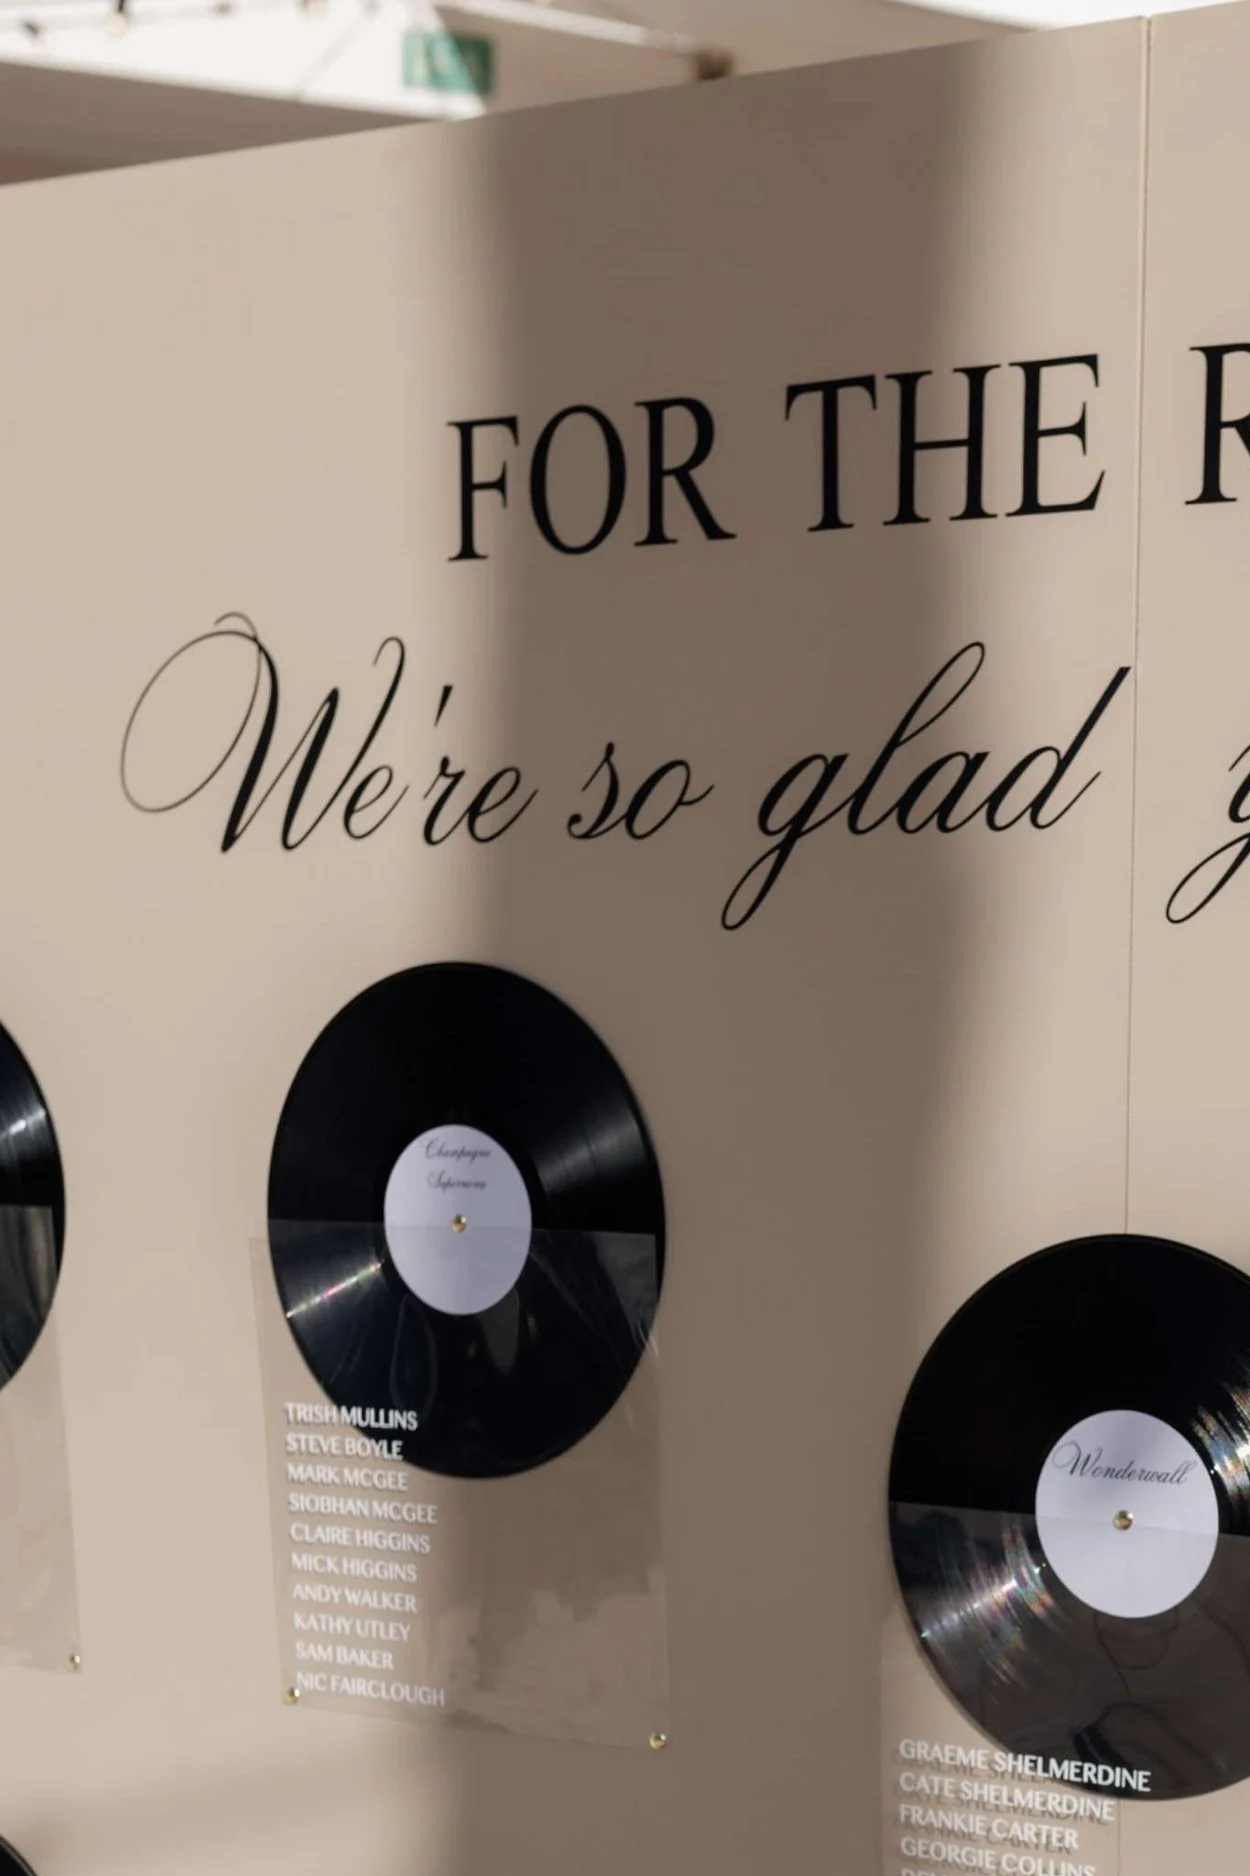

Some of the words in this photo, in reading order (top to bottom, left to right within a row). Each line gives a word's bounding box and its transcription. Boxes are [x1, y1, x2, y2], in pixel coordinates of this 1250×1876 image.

[447, 396, 737, 562] FOR
[784, 353, 1105, 532] THE
[121, 612, 539, 853] We're
[568, 742, 714, 840] so
[720, 641, 1132, 930] glad
[421, 1137, 492, 1165] Champagne
[427, 1170, 487, 1193] Supernova
[284, 1403, 337, 1426] TRISH
[341, 1407, 417, 1431] MULLINS
[286, 1433, 340, 1455] STEVE
[346, 1437, 403, 1460] BOYLE
[287, 1464, 340, 1485] MARK
[344, 1468, 408, 1491] MCGEE
[1052, 1440, 1197, 1485] Wonderwall
[289, 1493, 370, 1517] SIOBHAN
[373, 1500, 438, 1523] MCGEE
[291, 1523, 352, 1546] CLAIRE
[356, 1529, 431, 1554] HIGGINS
[291, 1554, 338, 1575] MICK
[343, 1559, 417, 1583] HIGGINS
[293, 1584, 344, 1605] ANDY
[344, 1589, 417, 1613] WALKER
[294, 1613, 353, 1634] KATHY
[356, 1619, 410, 1642] UTLEY
[296, 1643, 334, 1663] SAM
[337, 1647, 393, 1670] BAKER
[297, 1673, 327, 1692] NIC
[332, 1677, 444, 1707] FAIRCLOUGH
[900, 1739, 989, 1769] GRAEME
[994, 1752, 1151, 1792] SHELMERDINE
[900, 1773, 954, 1798] CATE
[961, 1781, 1115, 1821] SHELMERDINE
[901, 1805, 986, 1835] FRANKIE
[992, 1819, 1078, 1849] CARTER
[901, 1837, 997, 1870] GEORGIE
